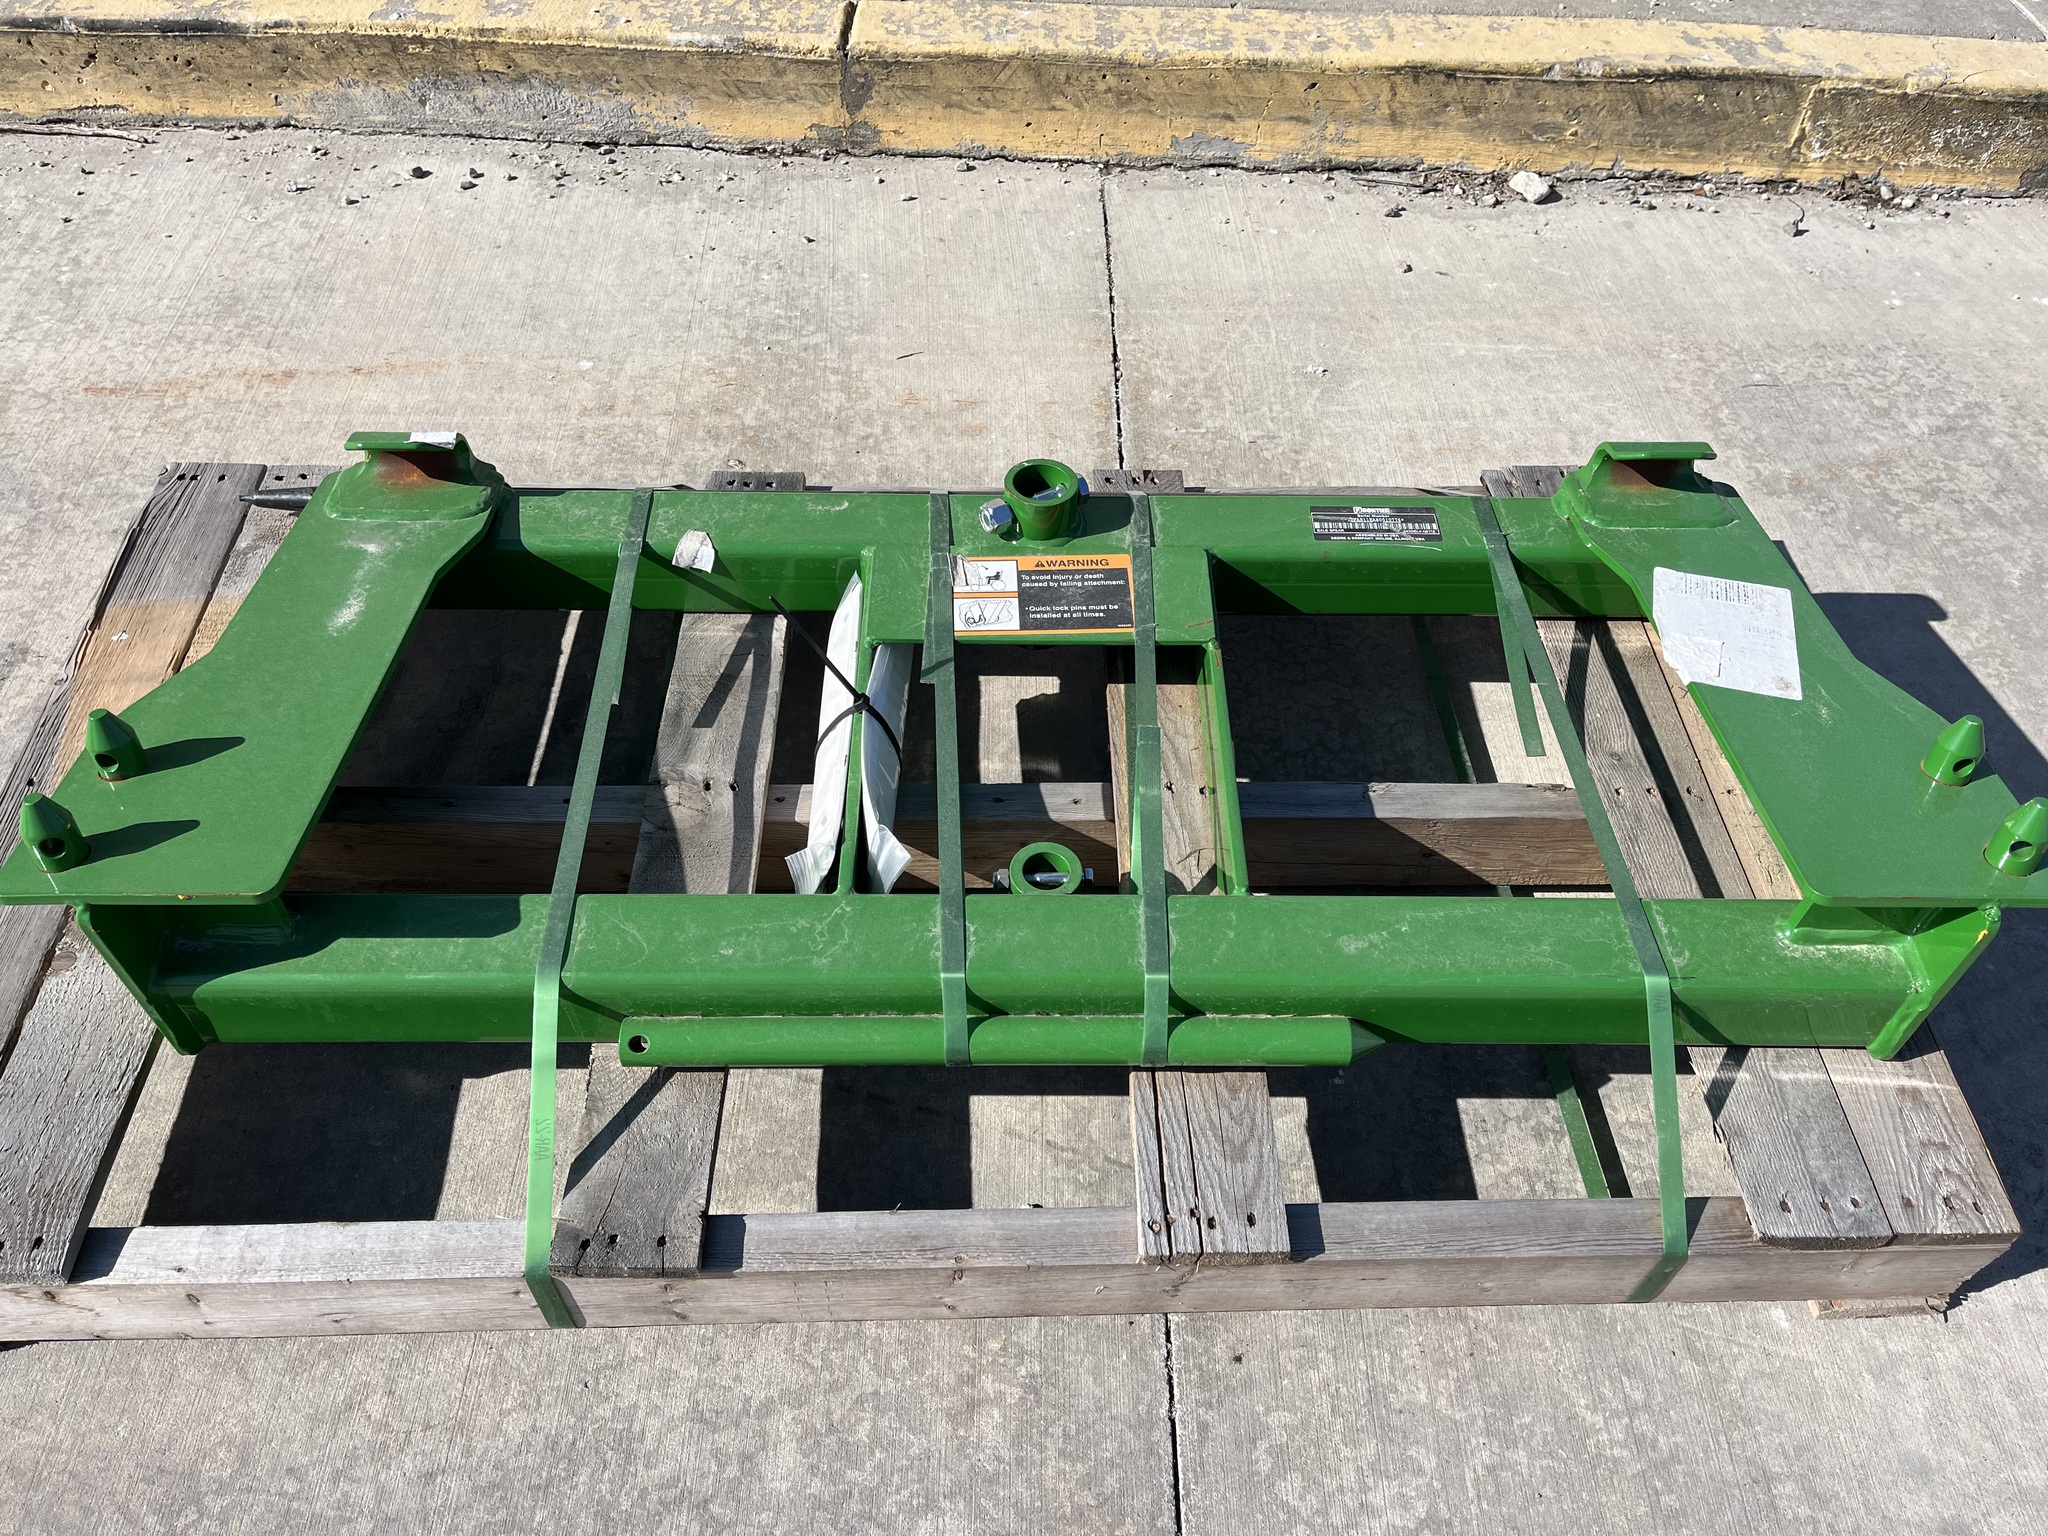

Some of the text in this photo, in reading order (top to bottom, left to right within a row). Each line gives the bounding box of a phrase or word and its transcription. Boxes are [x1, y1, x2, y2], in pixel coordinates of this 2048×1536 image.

[1046, 559, 1109, 567] WARNING
[1031, 573, 1051, 581] avoid
[1052, 573, 1073, 582] injury
[1049, 580, 1058, 588] by
[1060, 580, 1082, 588] falling
